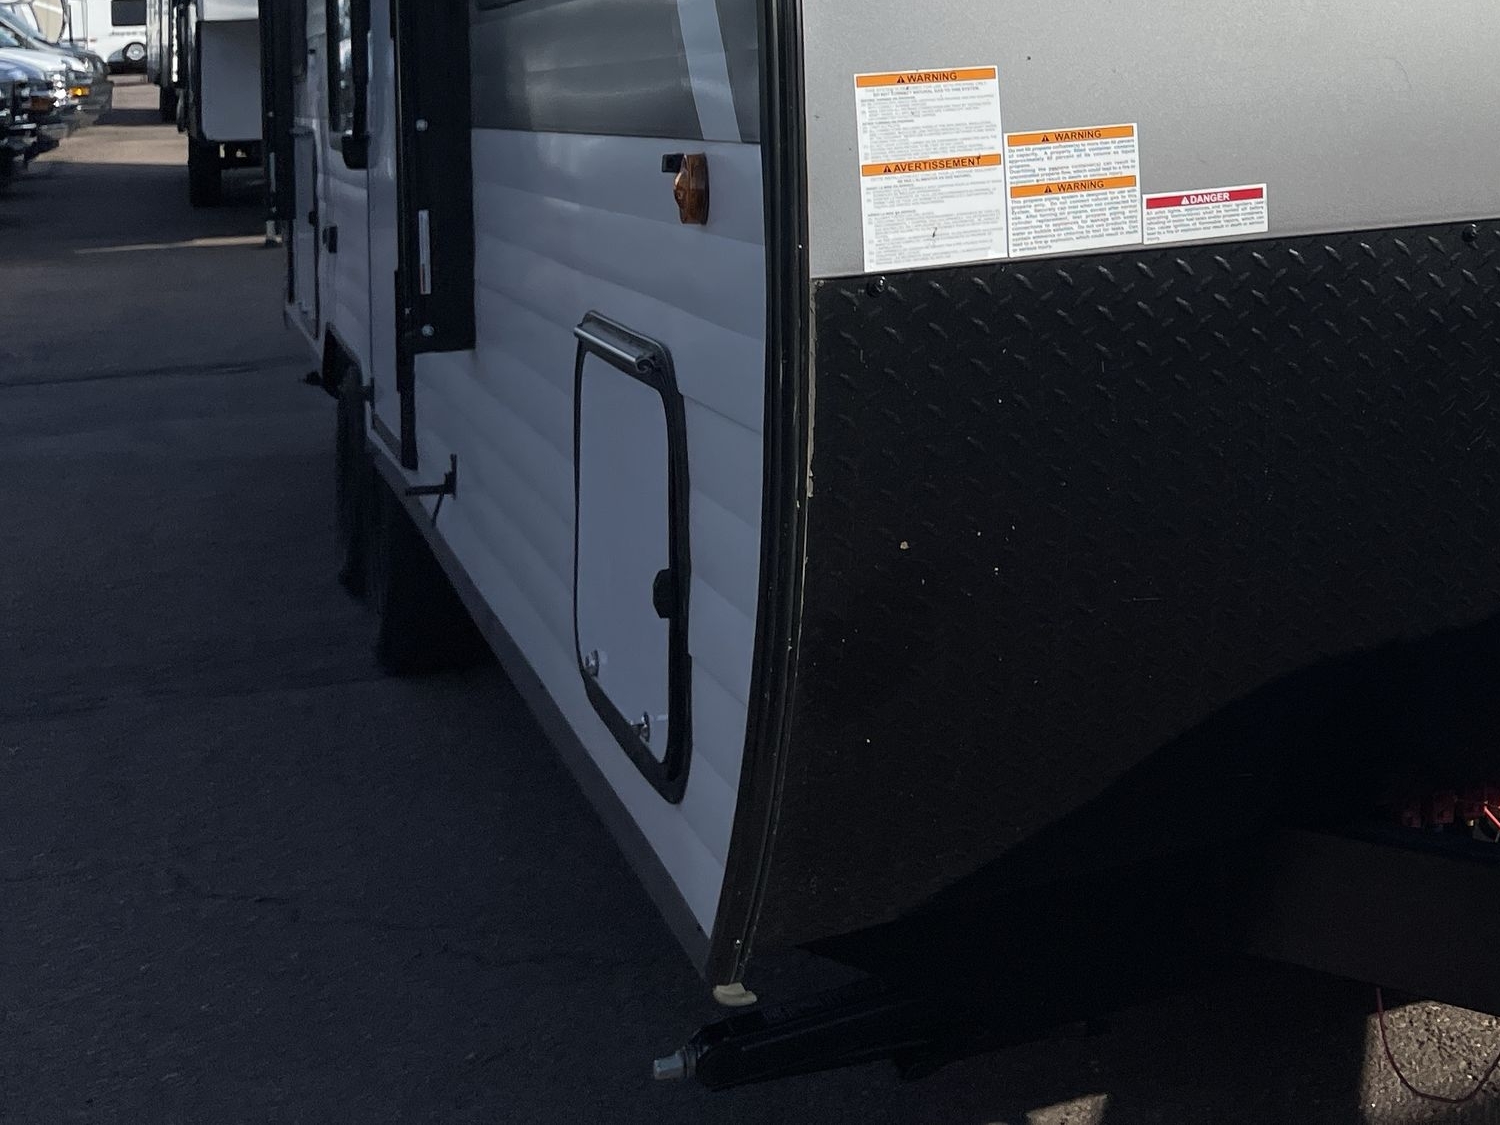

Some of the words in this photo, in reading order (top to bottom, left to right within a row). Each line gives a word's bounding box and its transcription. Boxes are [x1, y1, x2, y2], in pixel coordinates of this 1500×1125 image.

[906, 72, 957, 83] WARNING
[1054, 130, 1101, 141] WARNING
[893, 156, 981, 172] AVERTISSEMENT
[1057, 181, 1104, 191] WARNING
[1190, 193, 1230, 204] DANGER
